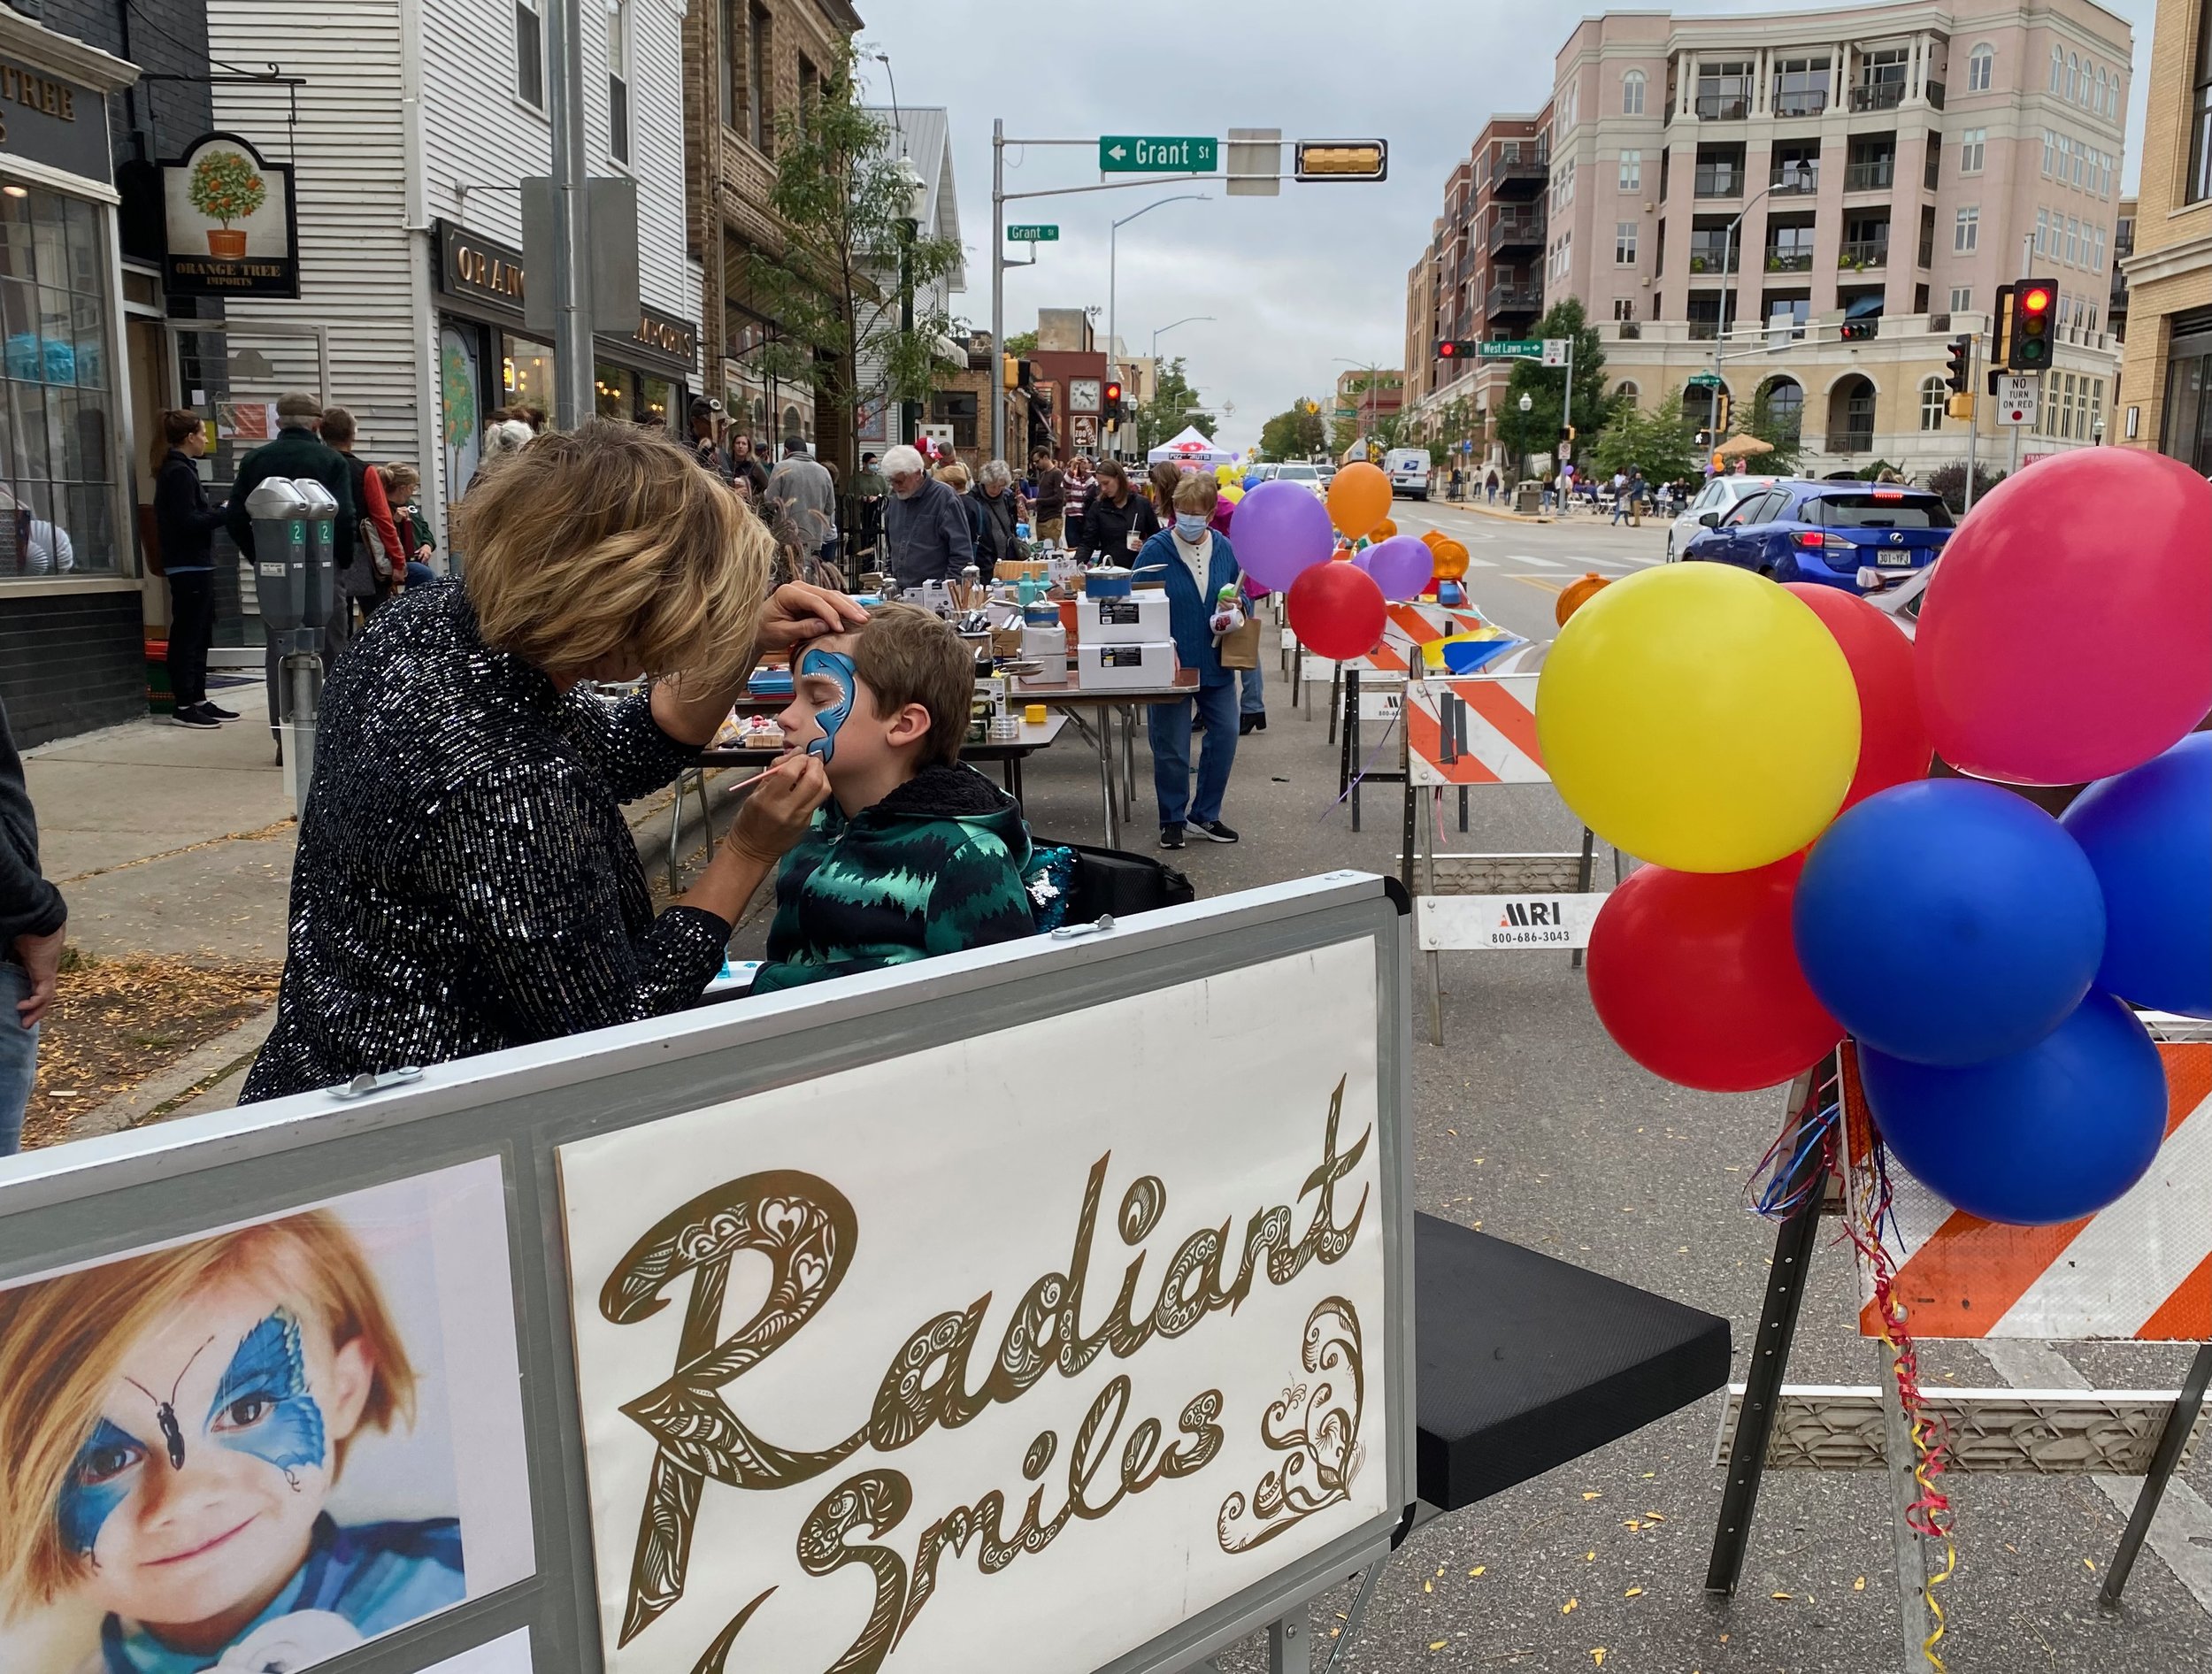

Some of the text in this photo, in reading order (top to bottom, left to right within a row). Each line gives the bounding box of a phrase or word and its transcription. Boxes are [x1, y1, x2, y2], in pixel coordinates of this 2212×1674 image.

[1135, 139, 1210, 165] Grant St
[1011, 226, 1041, 239] Grant
[176, 263, 281, 277] ORANGE TREE
[206, 276, 252, 286] IMPORTS
[1484, 343, 1502, 353] West
[1502, 344, 1521, 353] Lawn
[2012, 378, 2026, 389] NO
[2009, 390, 2029, 399] TURN
[2003, 400, 2033, 409] ON RED
[294, 525, 300, 540] 2
[323, 525, 328, 539] 2
[1492, 931, 1570, 943] 800-686-3043
[599, 1072, 1371, 1649] Radiant
[690, 1374, 1226, 1674] Smiles
